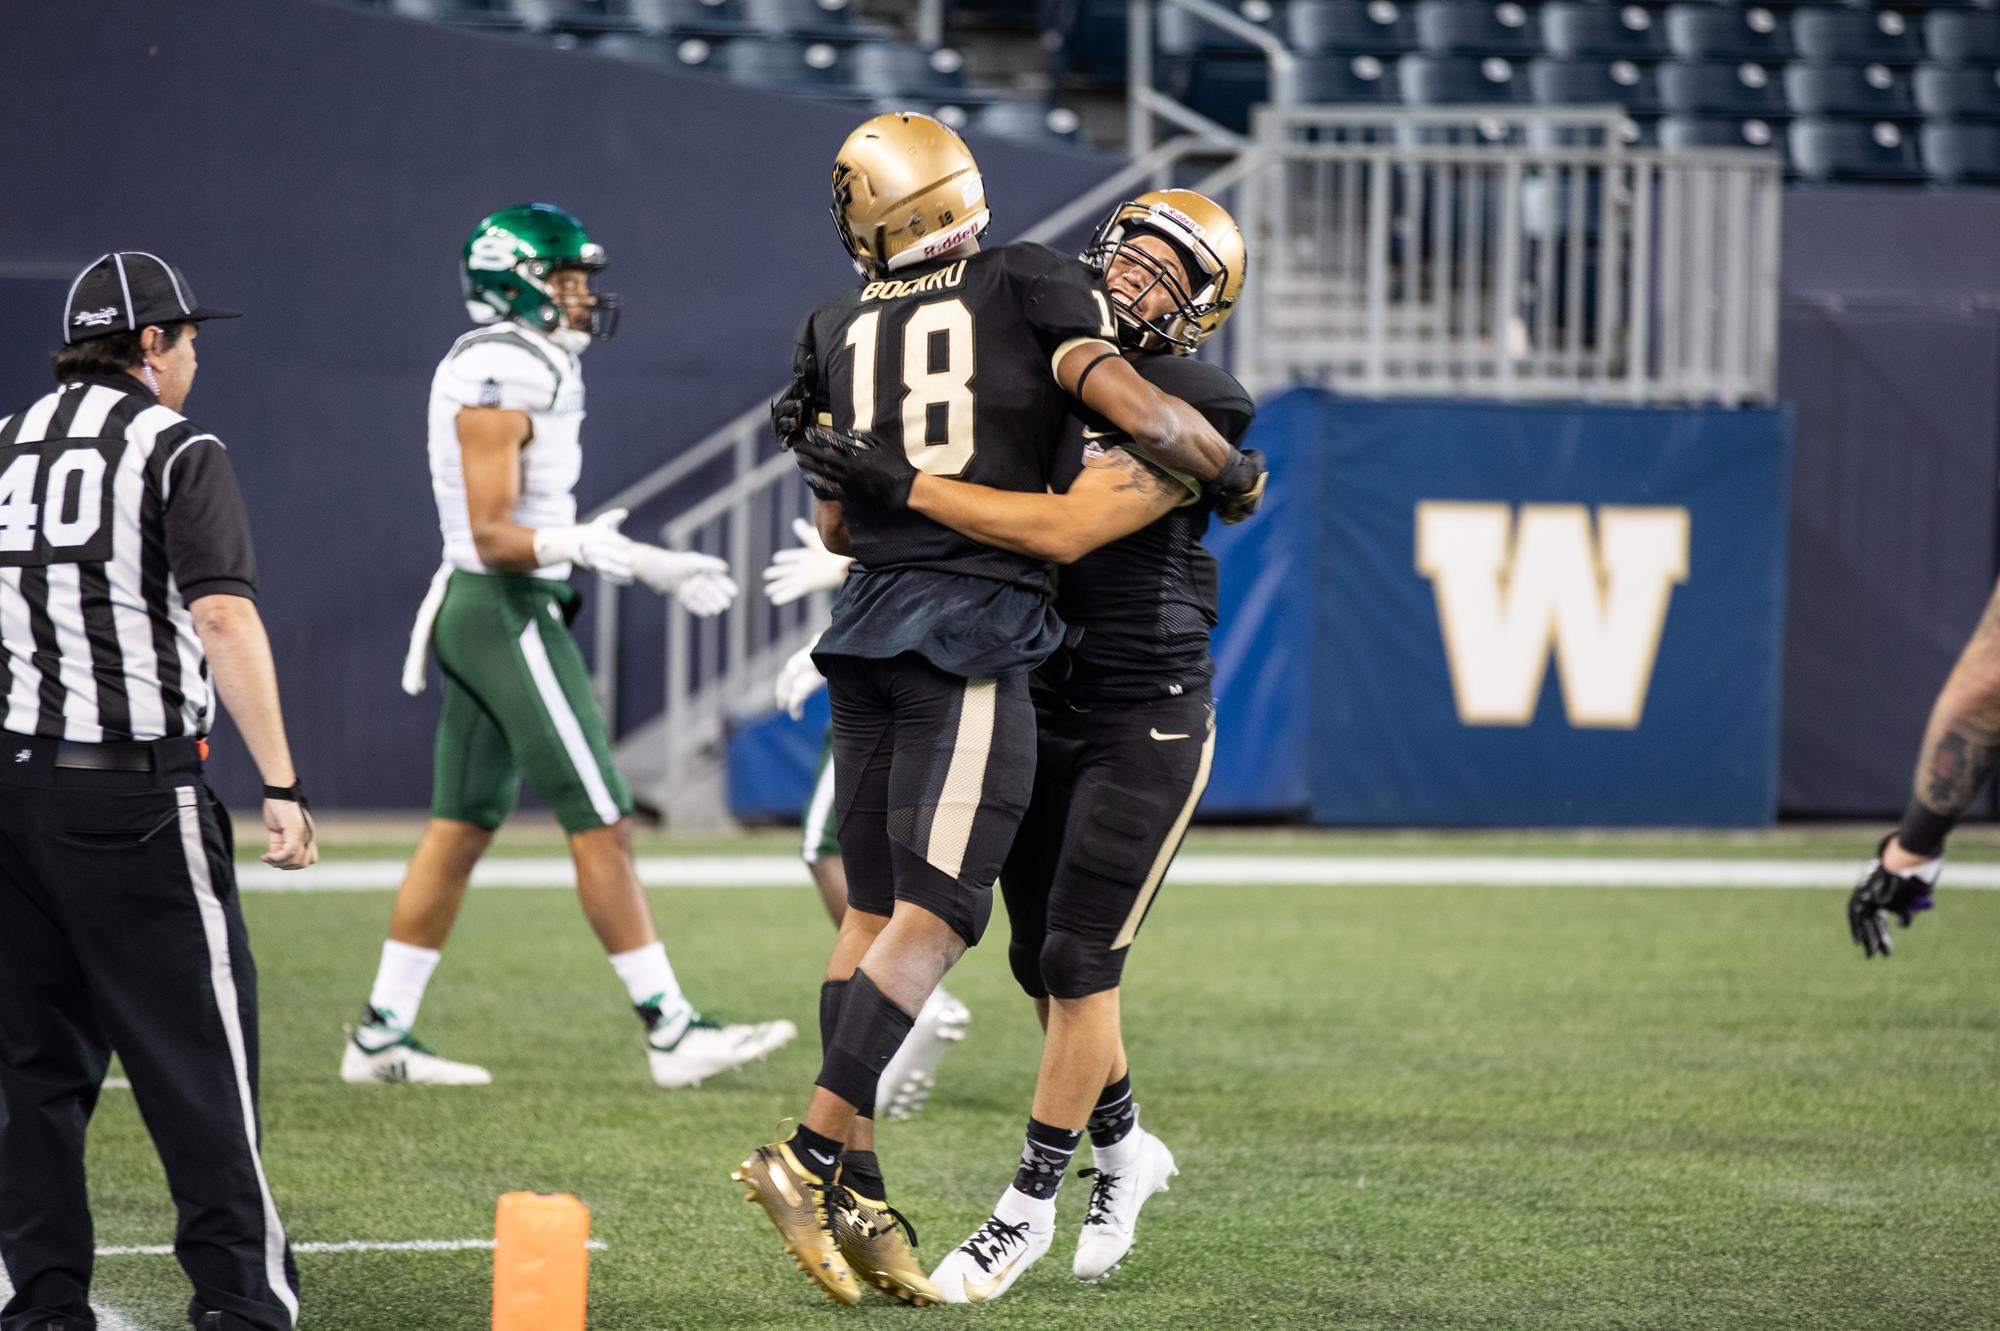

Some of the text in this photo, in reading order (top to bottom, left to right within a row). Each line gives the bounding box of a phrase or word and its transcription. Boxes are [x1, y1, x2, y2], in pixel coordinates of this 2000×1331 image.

[922, 221, 979, 258] Riddell
[1168, 208, 1196, 230] Riddell
[1090, 288, 1119, 338] 1
[844, 297, 977, 477] 18
[0, 447, 108, 553] 40
[1415, 501, 1690, 729] W
